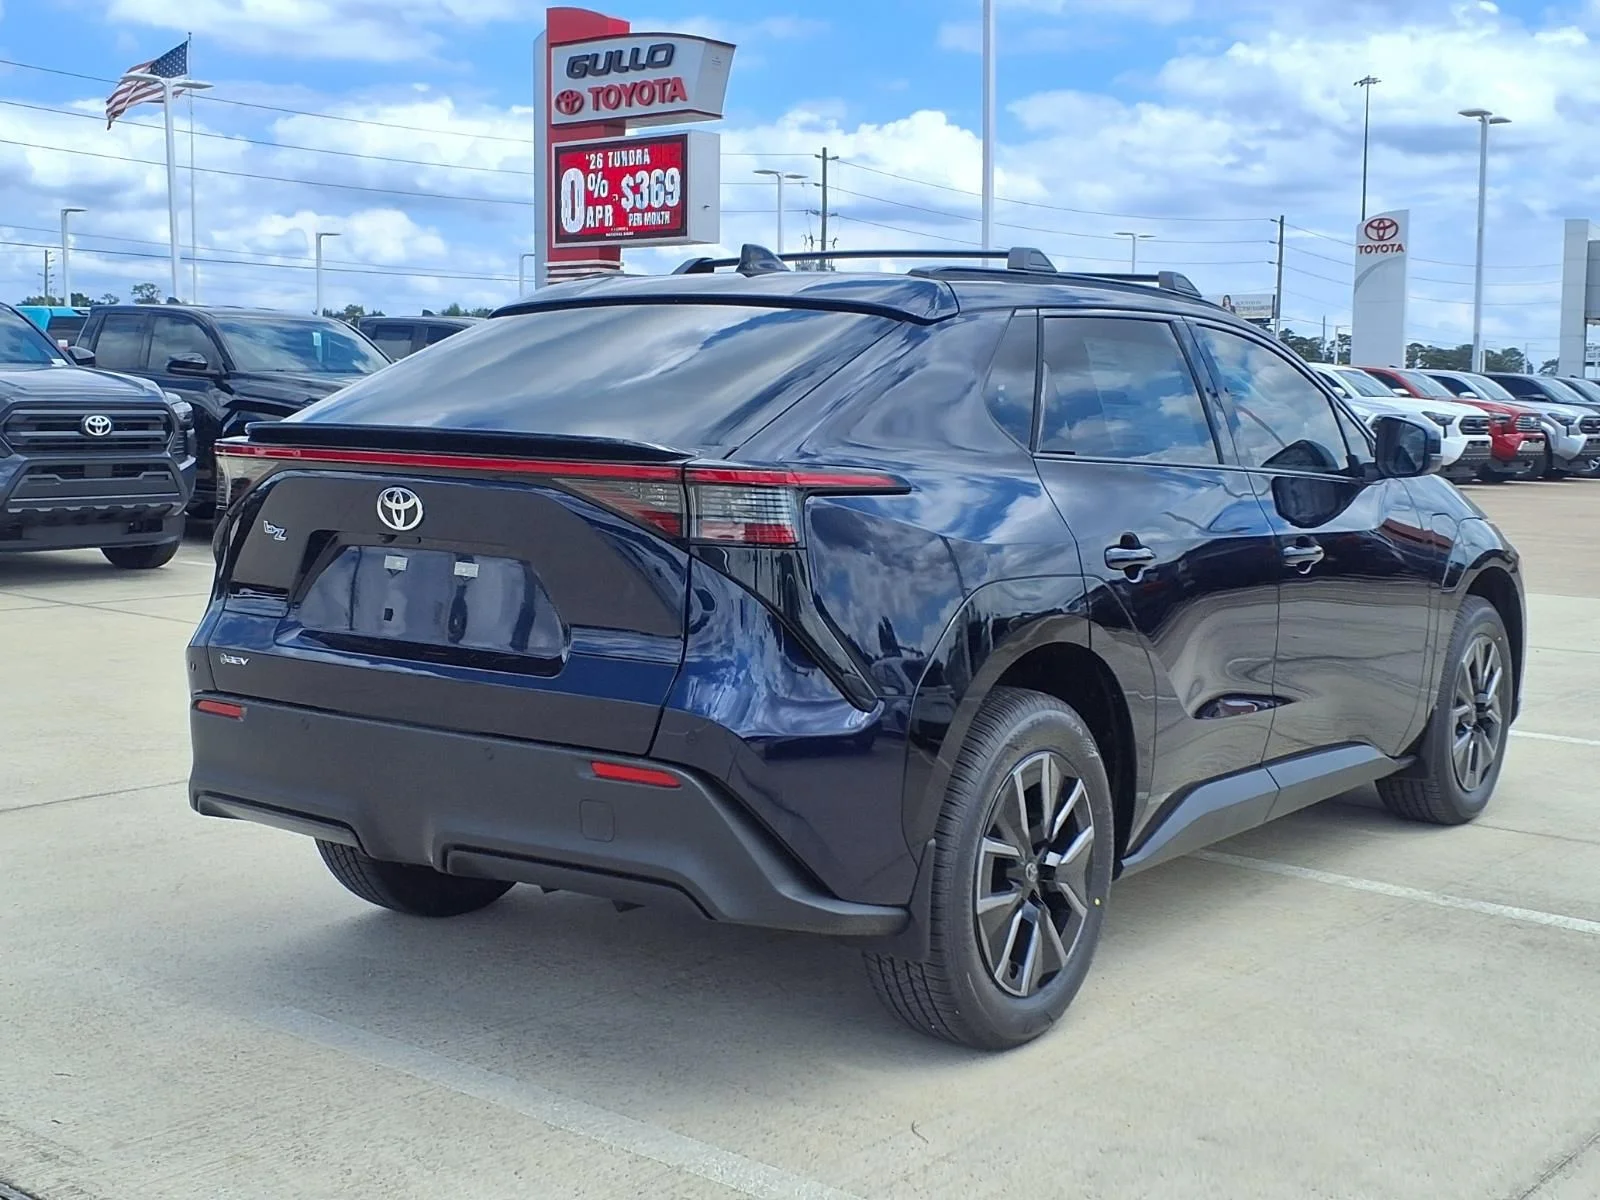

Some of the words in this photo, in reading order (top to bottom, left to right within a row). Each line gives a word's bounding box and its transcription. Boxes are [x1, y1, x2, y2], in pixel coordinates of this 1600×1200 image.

[566, 43, 675, 79] GULLO
[588, 77, 688, 111] TOYOTA
[608, 148, 651, 168] TUNDRA
[621, 167, 681, 212] $369
[586, 204, 614, 228] APR
[644, 210, 671, 225] MONTH
[1358, 244, 1404, 254] TOYOTA
